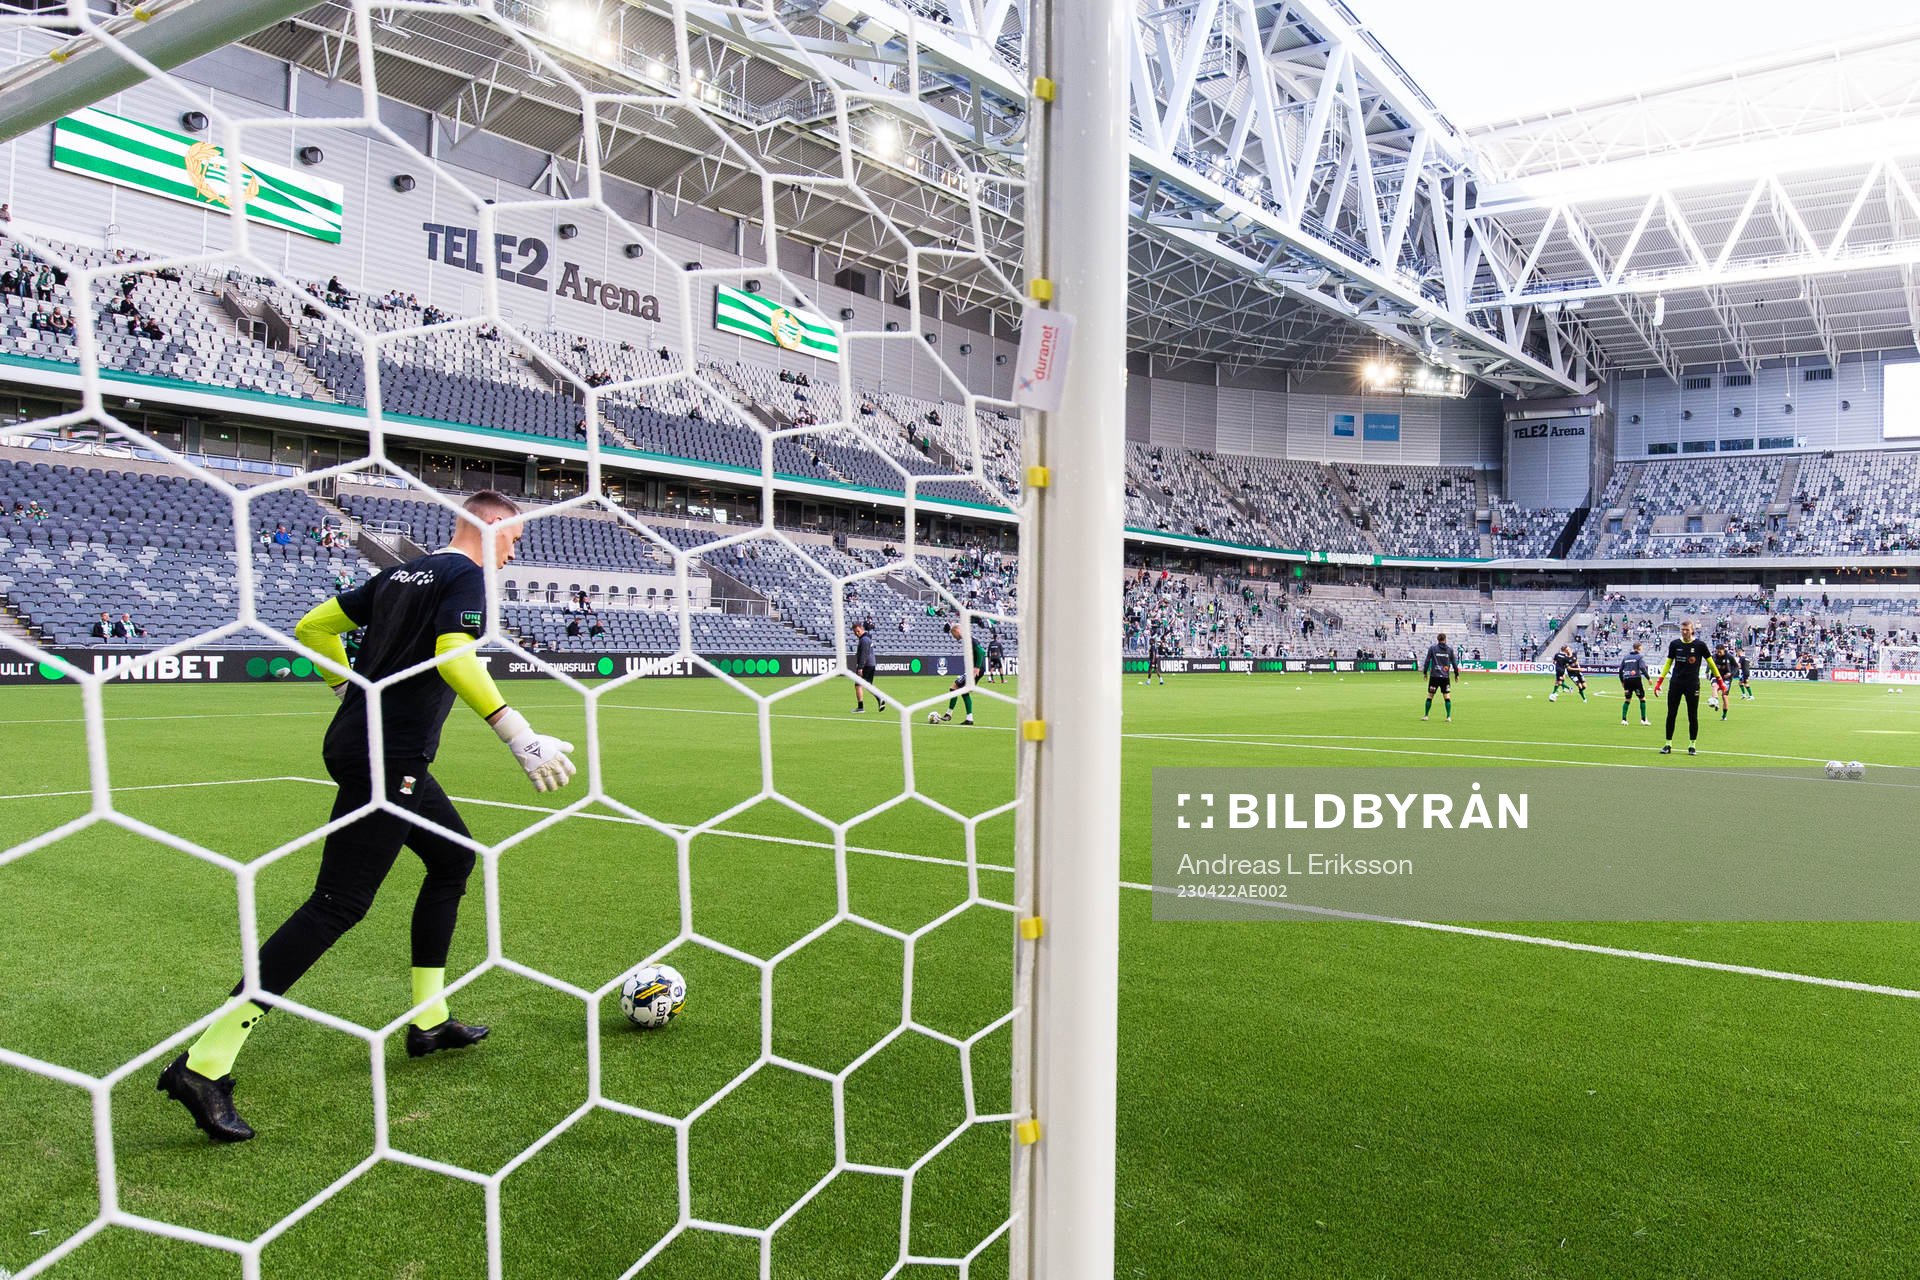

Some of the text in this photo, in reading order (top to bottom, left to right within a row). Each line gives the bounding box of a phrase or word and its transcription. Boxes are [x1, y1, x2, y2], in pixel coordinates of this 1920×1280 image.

[423, 222, 661, 323] TELE2 Arena
[1034, 325, 1054, 380] duranet
[1513, 424, 1585, 438] TELE2 Arena
[93, 655, 224, 680] UNIBET
[509, 663, 534, 672] SPELA
[791, 658, 837, 675] UNIBE
[1160, 660, 1189, 672] UNIBET
[1229, 660, 1254, 671] UNIBET
[1509, 664, 1555, 673] INTERSPO
